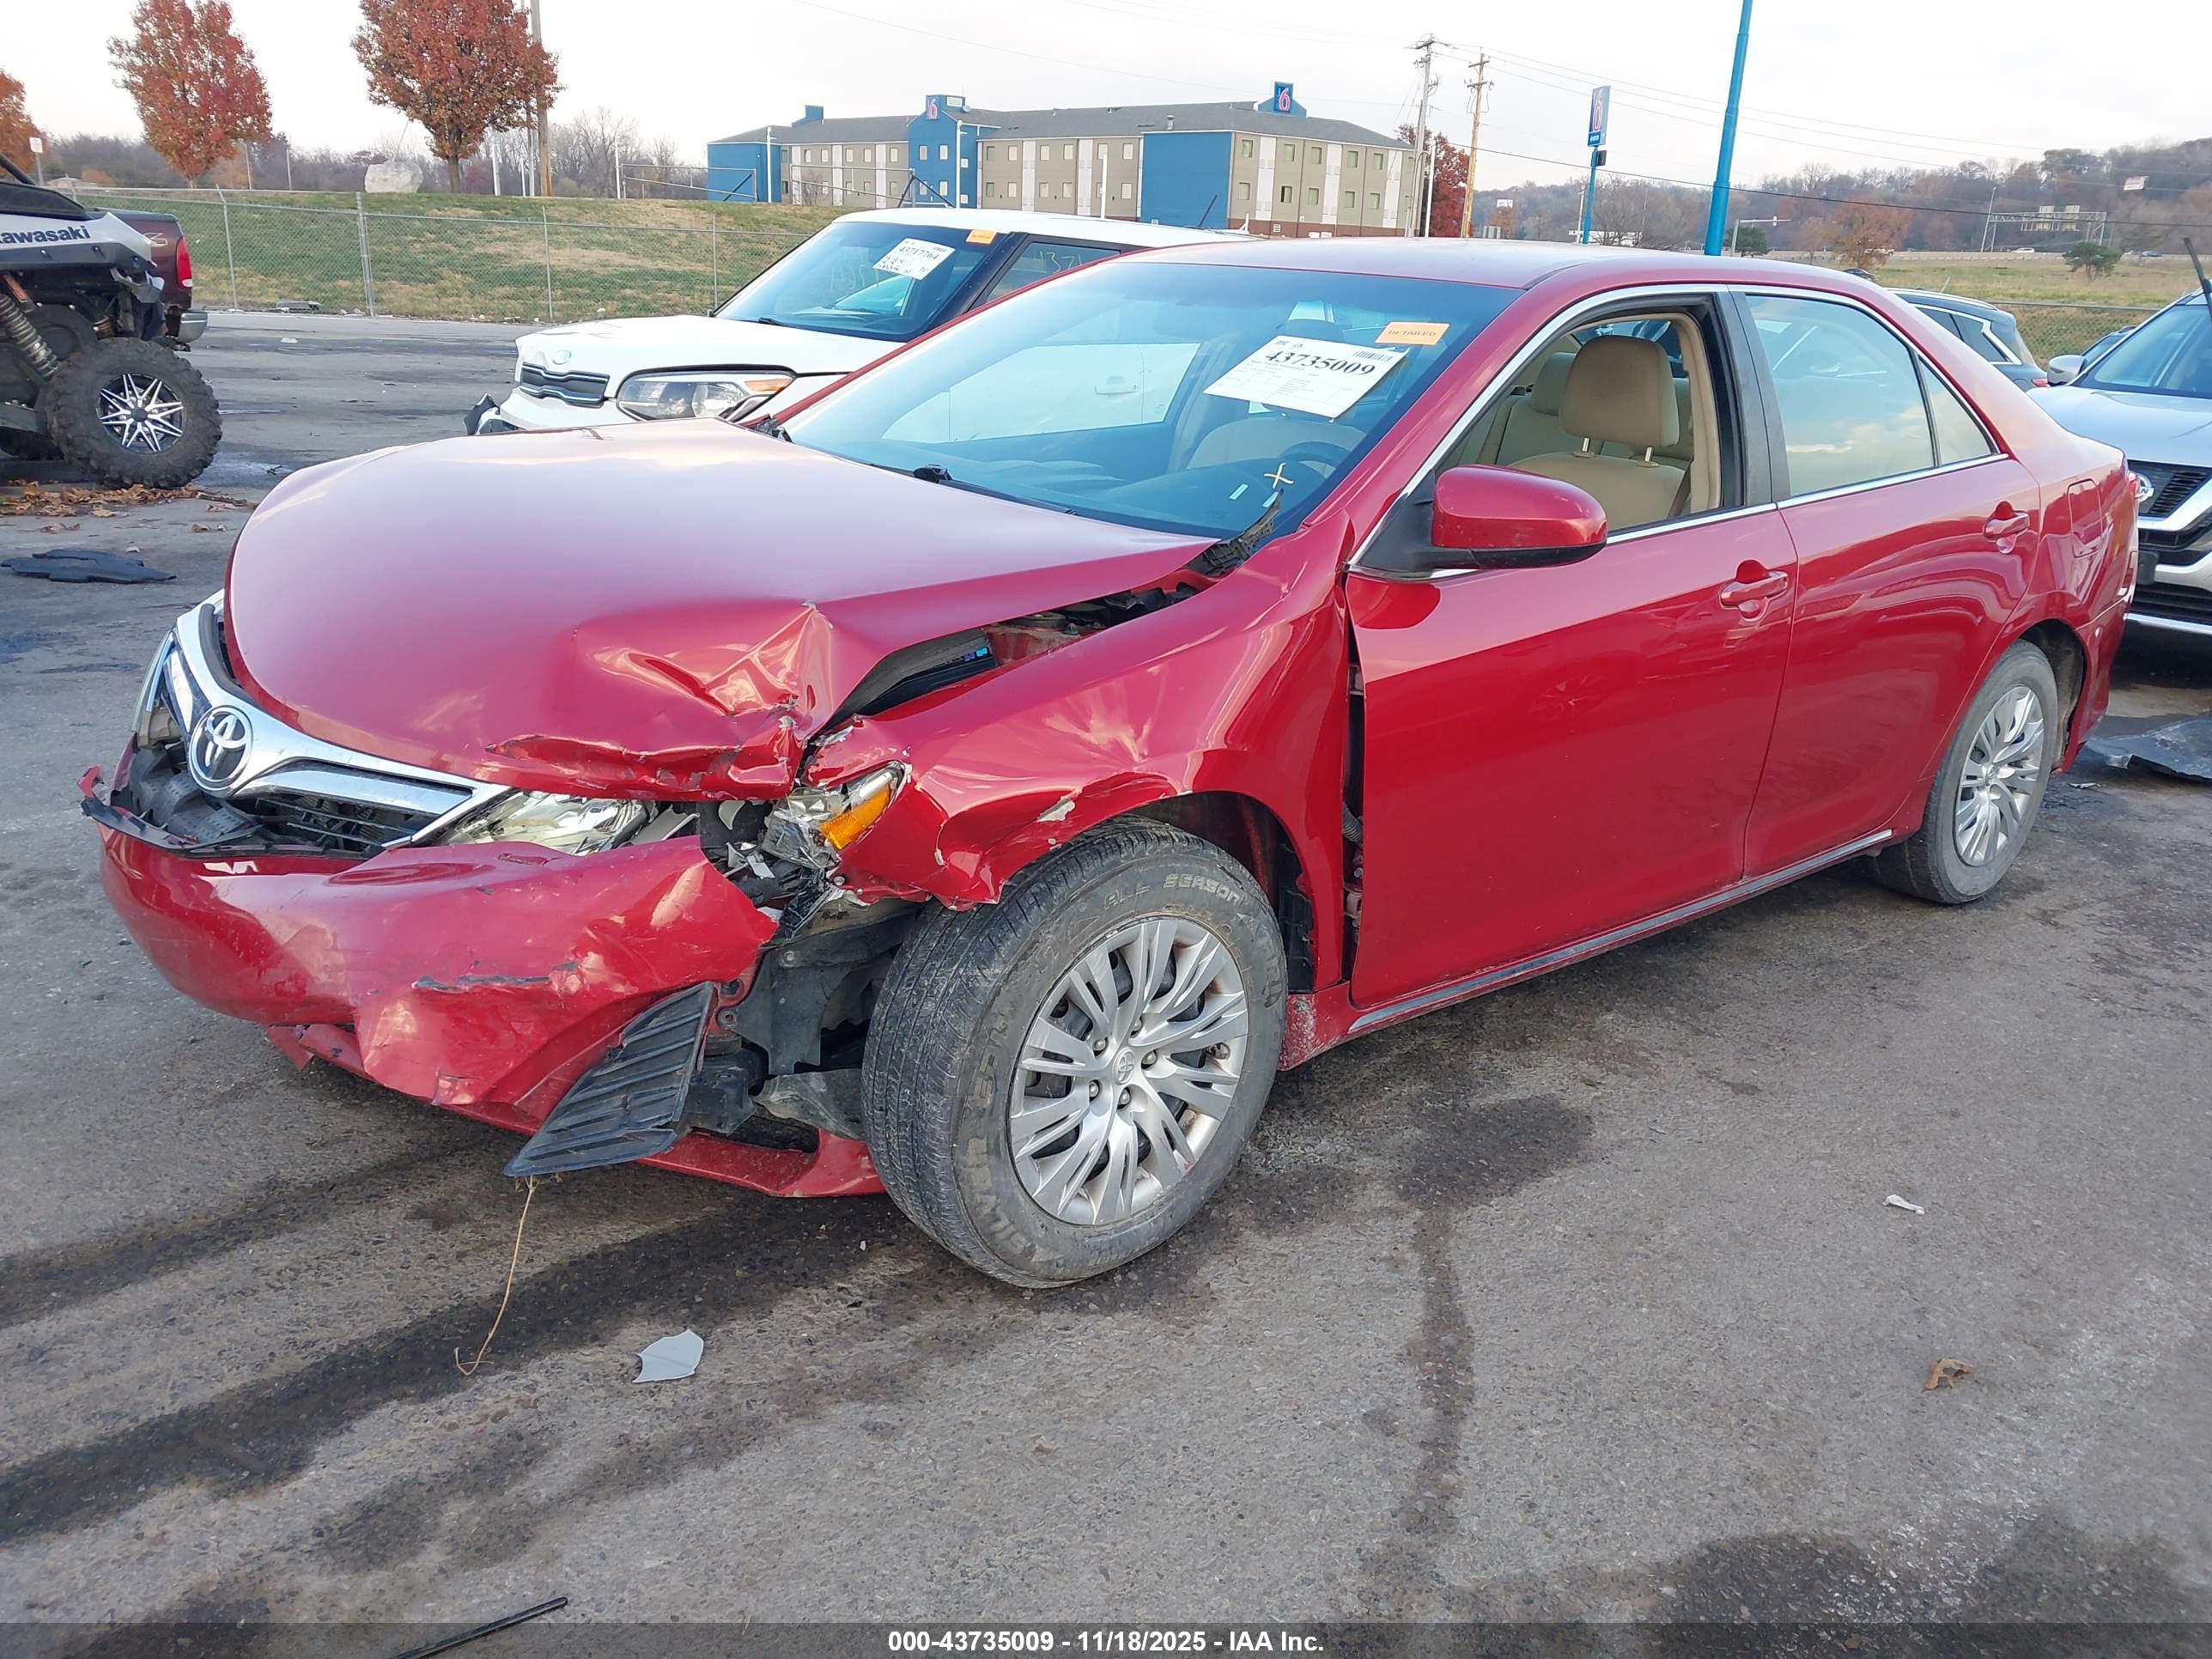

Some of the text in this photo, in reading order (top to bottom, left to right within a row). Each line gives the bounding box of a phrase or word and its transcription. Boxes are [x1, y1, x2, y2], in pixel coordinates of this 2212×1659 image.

[1279, 87, 1291, 111] 6
[0, 226, 91, 245] awasaki
[1388, 329, 1437, 337] DETAILED
[1265, 350, 1376, 376] 43735009
